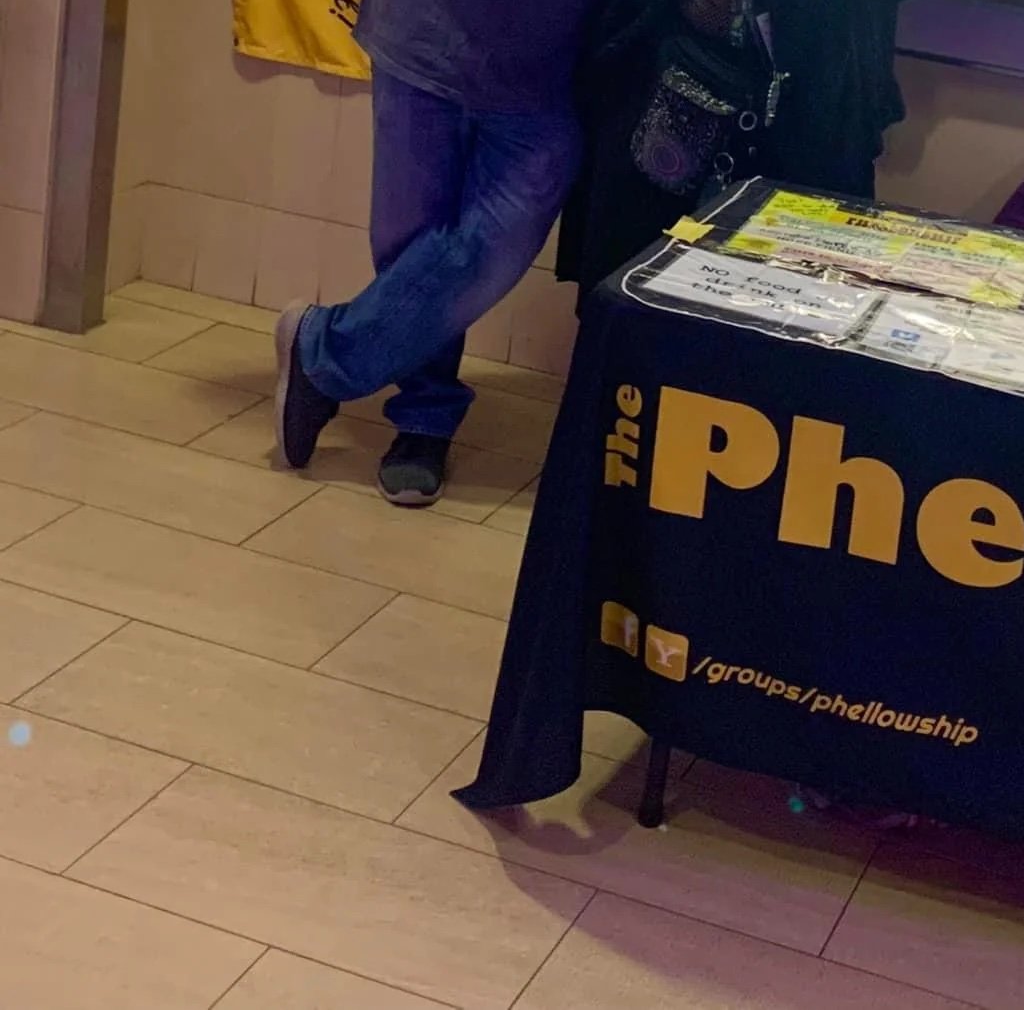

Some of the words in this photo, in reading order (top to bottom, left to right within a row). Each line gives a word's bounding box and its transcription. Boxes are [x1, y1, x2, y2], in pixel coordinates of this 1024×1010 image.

[691, 282, 733, 297] the
[699, 264, 730, 277] NO
[746, 276, 803, 295] food
[705, 276, 779, 298] drink
[605, 383, 643, 487] The
[691, 656, 980, 747] /groups/phellowship
